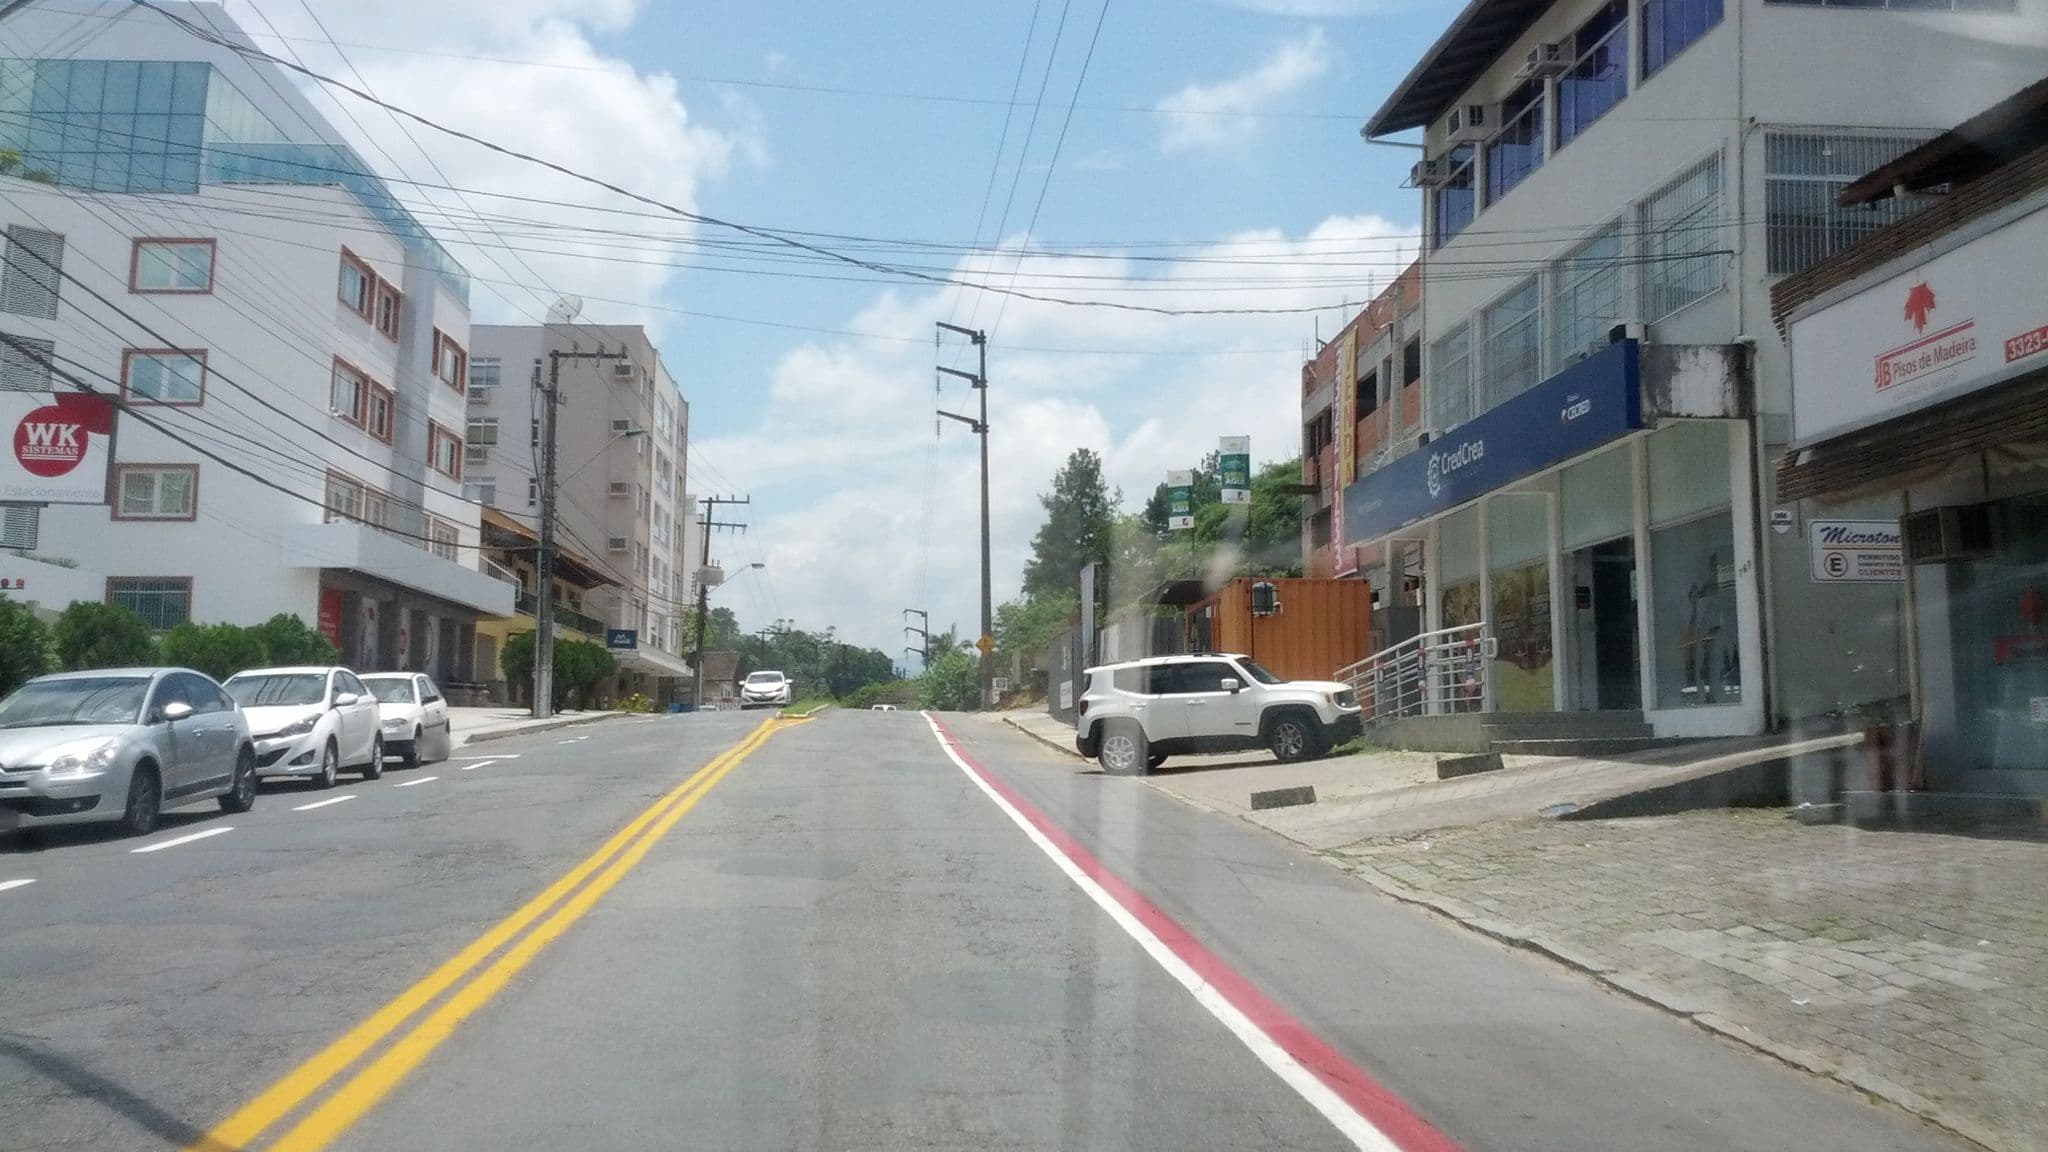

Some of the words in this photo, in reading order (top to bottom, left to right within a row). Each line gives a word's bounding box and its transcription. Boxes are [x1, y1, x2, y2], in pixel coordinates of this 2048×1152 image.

[1892, 360, 1918, 380] Pisos
[1918, 351, 1932, 369] de
[1932, 338, 1976, 364] Madeira
[24, 422, 81, 447] WK
[21, 445, 79, 456] SISTEMAS
[1441, 439, 1484, 475] CredCrea
[1830, 557, 1842, 572] E
